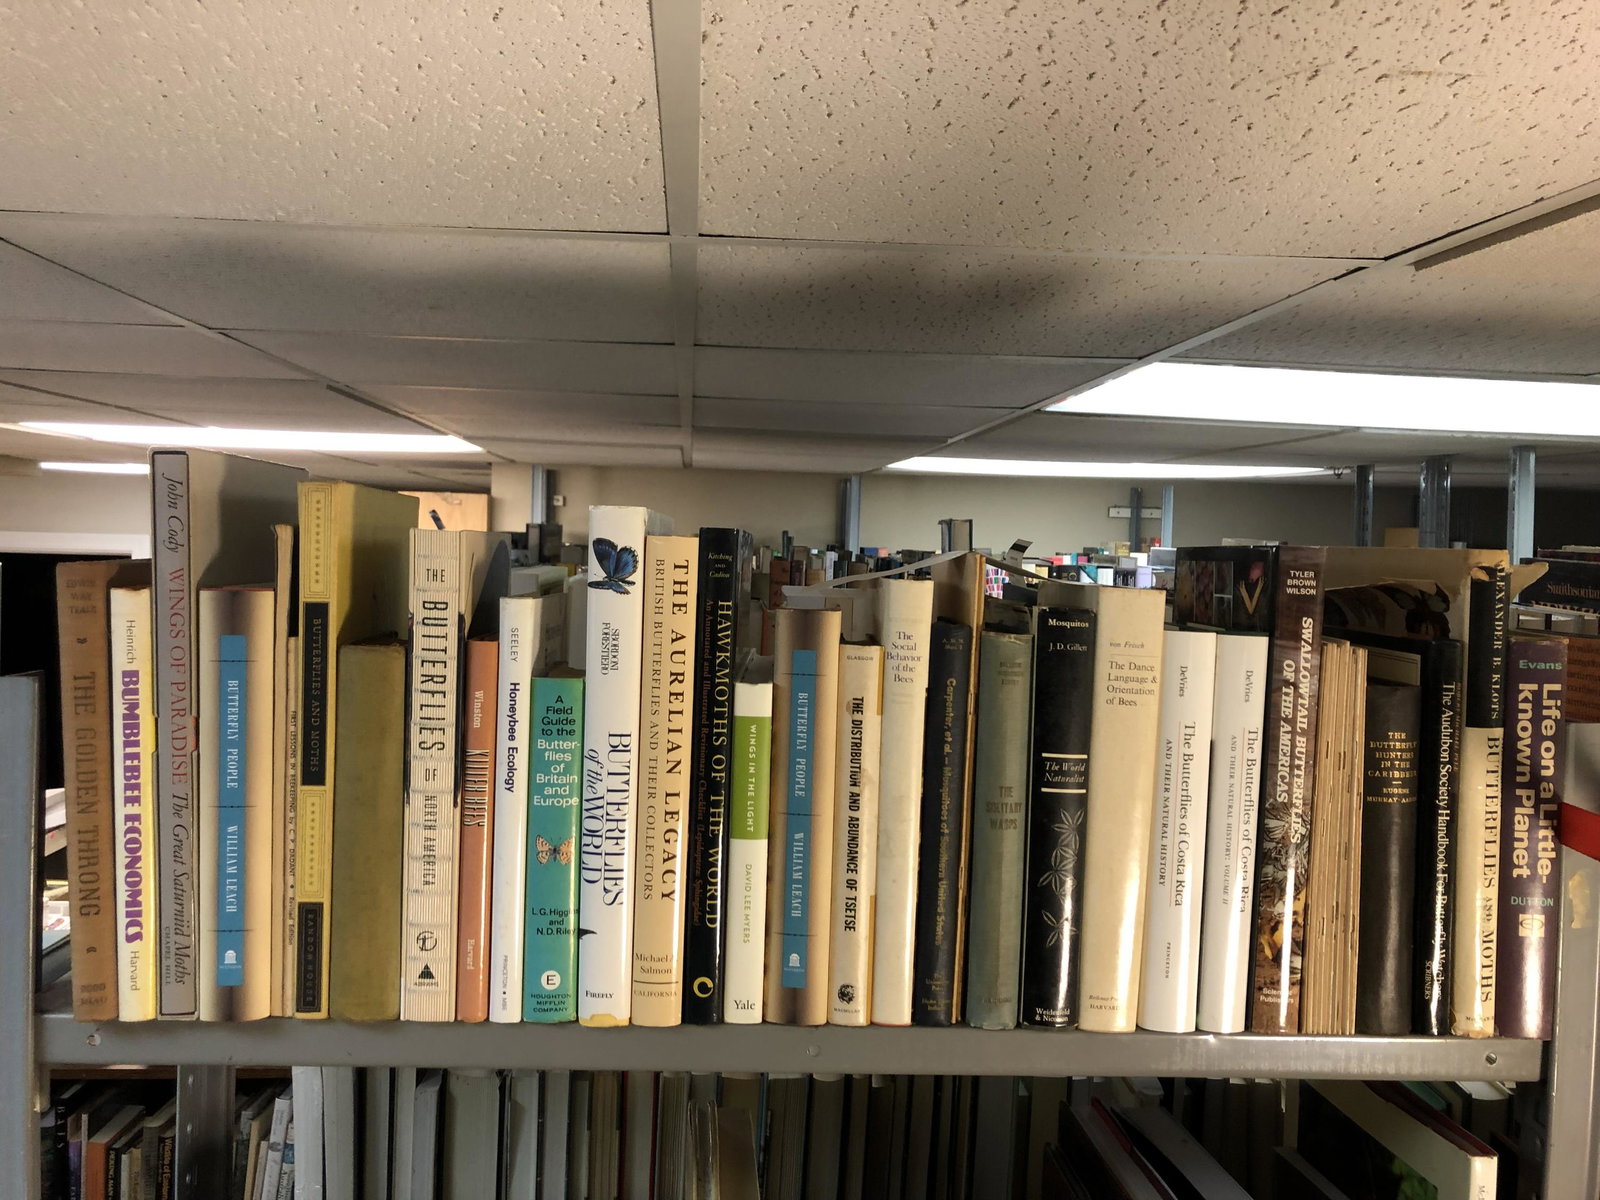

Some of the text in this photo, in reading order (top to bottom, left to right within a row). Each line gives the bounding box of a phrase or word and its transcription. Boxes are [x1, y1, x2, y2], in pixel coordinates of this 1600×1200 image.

[162, 472, 185, 554] John Cody
[426, 569, 446, 582] THE
[1286, 587, 1316, 595] WILSON
[1287, 579, 1317, 587] BROWN
[1290, 570, 1315, 578] TYLER
[896, 631, 913, 640] The
[1048, 618, 1089, 629] Mosquitos
[126, 619, 137, 664] Heinrich
[510, 627, 519, 662] SEELEY
[609, 628, 620, 671] SBORDONI
[886, 651, 922, 662] Behavior
[892, 642, 917, 651] Social
[168, 567, 189, 785] WINGS OF PARADISE
[418, 600, 448, 752] BUTTERFLIES
[893, 674, 914, 683] Bees
[1107, 673, 1157, 684] Language &
[1108, 661, 1155, 672] The Dance
[1178, 665, 1189, 698] DeVries
[1519, 660, 1563, 670] Evans
[310, 618, 322, 772] BUTTERFLIES AND MOTHS
[555, 695, 564, 704] A
[1105, 697, 1137, 706] of Bees
[1106, 685, 1155, 696] Orientation
[1244, 670, 1254, 703] DeVries
[1443, 681, 1456, 705] The
[473, 690, 484, 729] Winston
[541, 716, 576, 726] Guide
[546, 706, 573, 715] Field
[226, 680, 240, 789] BUTTERFLY PEOPLE
[504, 682, 521, 793] Honeybee Ecology
[541, 728, 576, 736] to the
[643, 559, 666, 901] BRITISH BUTTERFLIES AND THEIR COLLECTORS
[661, 560, 690, 902] THE AURELIAN LEGACY
[794, 692, 809, 798] BUTTERFLY PEOPLE
[1246, 727, 1259, 754] The
[1276, 659, 1296, 802] OF THE AMERICAS
[1290, 617, 1313, 843] SWALLOWTAIL BUTTERFLIES
[1440, 707, 1454, 761] Audubon
[544, 751, 572, 761] flies
[551, 763, 565, 773] of
[705, 600, 733, 929] HAWKMOTHS OF THE WORLD
[1044, 761, 1086, 771] The World
[425, 768, 437, 782] OF
[536, 773, 578, 784] Britain
[543, 785, 569, 795] and
[746, 724, 757, 832] WINGS IN THE LIGHT
[1044, 772, 1085, 783] Naturalist
[1243, 758, 1257, 825] Butterflies
[1436, 764, 1452, 808] Society
[1512, 683, 1538, 878] known Planet
[1537, 683, 1562, 884] Life on a Little-
[73, 672, 101, 917] THE GOLDEN THRONG
[121, 669, 143, 944] BUMBLEBEE ECONOMICS
[533, 796, 579, 808] Europe
[582, 748, 604, 884] of the WORLD
[603, 731, 632, 906] BUTTERFLIES
[844, 696, 864, 932] THE DISTRIBUTION AND ABUNDANCE OF TSETSE
[1158, 739, 1173, 887] AND THEIR NATURAL HISTORY
[1174, 721, 1196, 907] The Butterflies of Costa Rica
[1483, 736, 1501, 889] BUTTERFLIES
[422, 795, 437, 887] NORTH AMERICA
[1241, 829, 1254, 843] of
[1436, 810, 1450, 871] Handbook
[225, 825, 238, 913] WILLIAM LEACH
[791, 832, 804, 918] WILLIAM LEACH
[1239, 845, 1252, 881] Costa
[172, 792, 191, 985] The Great Saturniid Moths
[1436, 873, 1448, 894] For
[742, 863, 753, 944] DAVID LEE MYERS
[548, 918, 564, 926] and
[129, 950, 140, 991] Harvard
[164, 964, 172, 986] HILL
[635, 953, 668, 963] Michael
[640, 966, 672, 974] Salmon
[1481, 930, 1495, 1003] MOTHS
[546, 974, 556, 985] E
[1424, 960, 1432, 1000] SCRIBNERS
[734, 1000, 756, 1010] Yale
